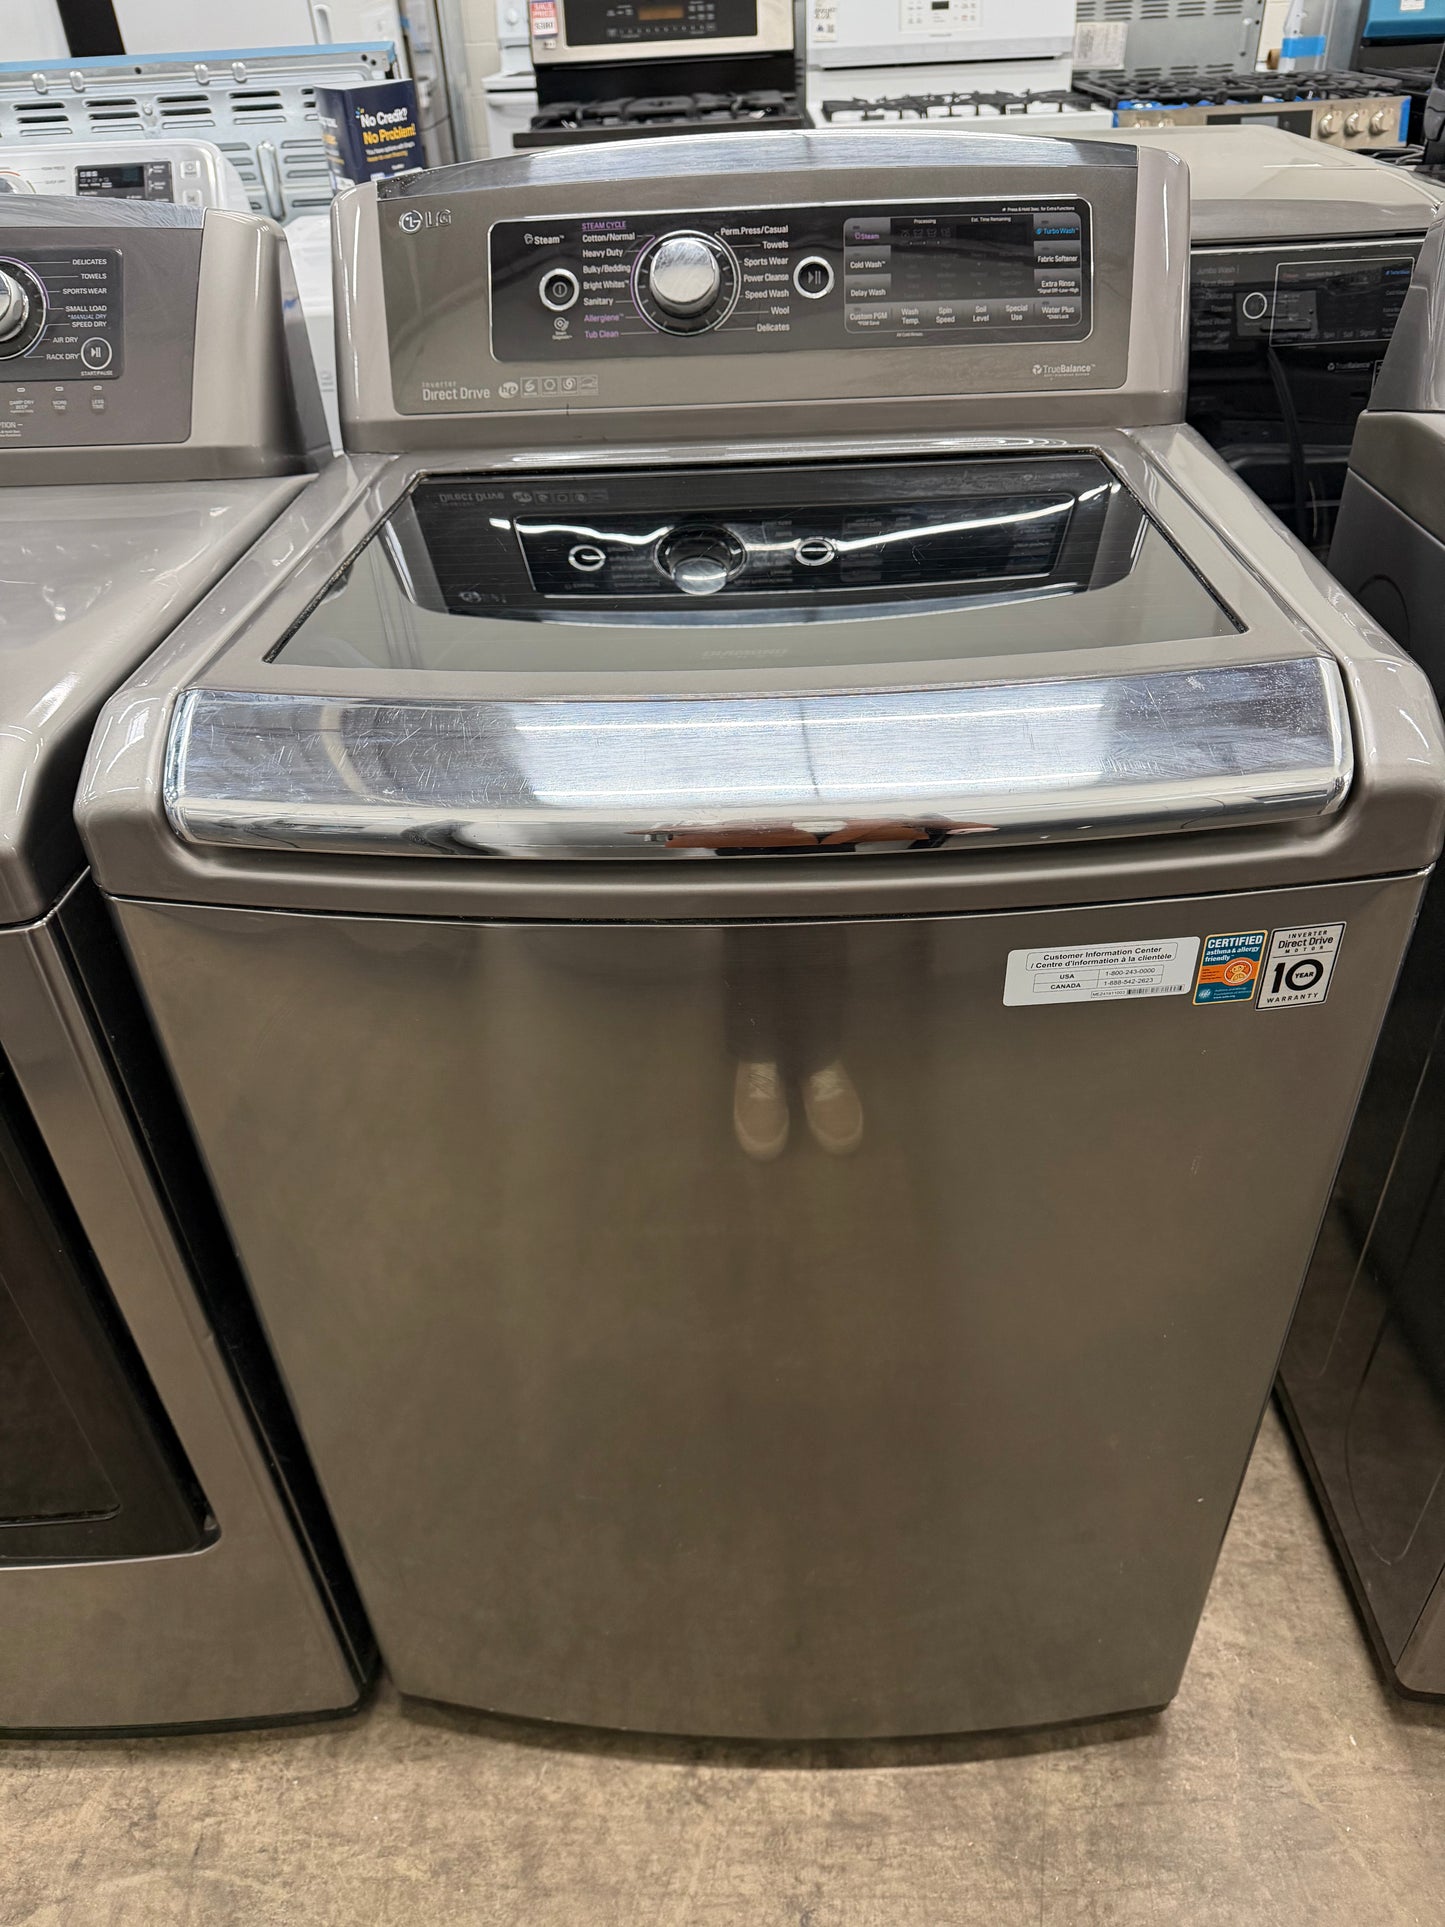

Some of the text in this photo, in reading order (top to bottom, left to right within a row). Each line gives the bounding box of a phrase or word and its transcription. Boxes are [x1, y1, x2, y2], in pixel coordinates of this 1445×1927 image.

[361, 108, 408, 128] No Credit?
[362, 122, 416, 144] No Problem!
[582, 221, 626, 230] STEAM CYCLE
[583, 232, 635, 242] Cotton/Normal
[762, 241, 788, 249] Towels
[744, 258, 768, 267] Sports
[583, 265, 631, 274] Bulky/Bedding
[583, 282, 602, 291] Bright
[745, 289, 789, 300] Speed Wash
[584, 298, 613, 306] Sanitary
[757, 323, 790, 332] Delicates
[423, 387, 490, 400] Direct Drive
[1288, 930, 1328, 939] INVERTER
[1208, 935, 1263, 948] CERTIFIED
[1278, 937, 1334, 949] Direct Drive
[1086, 949, 1132, 958] Information
[1065, 958, 1118, 966] d'information
[1106, 968, 1155, 976] 1-800-243-0000
[1272, 959, 1324, 993] 10
[1267, 993, 1318, 1003] WARRANTY
